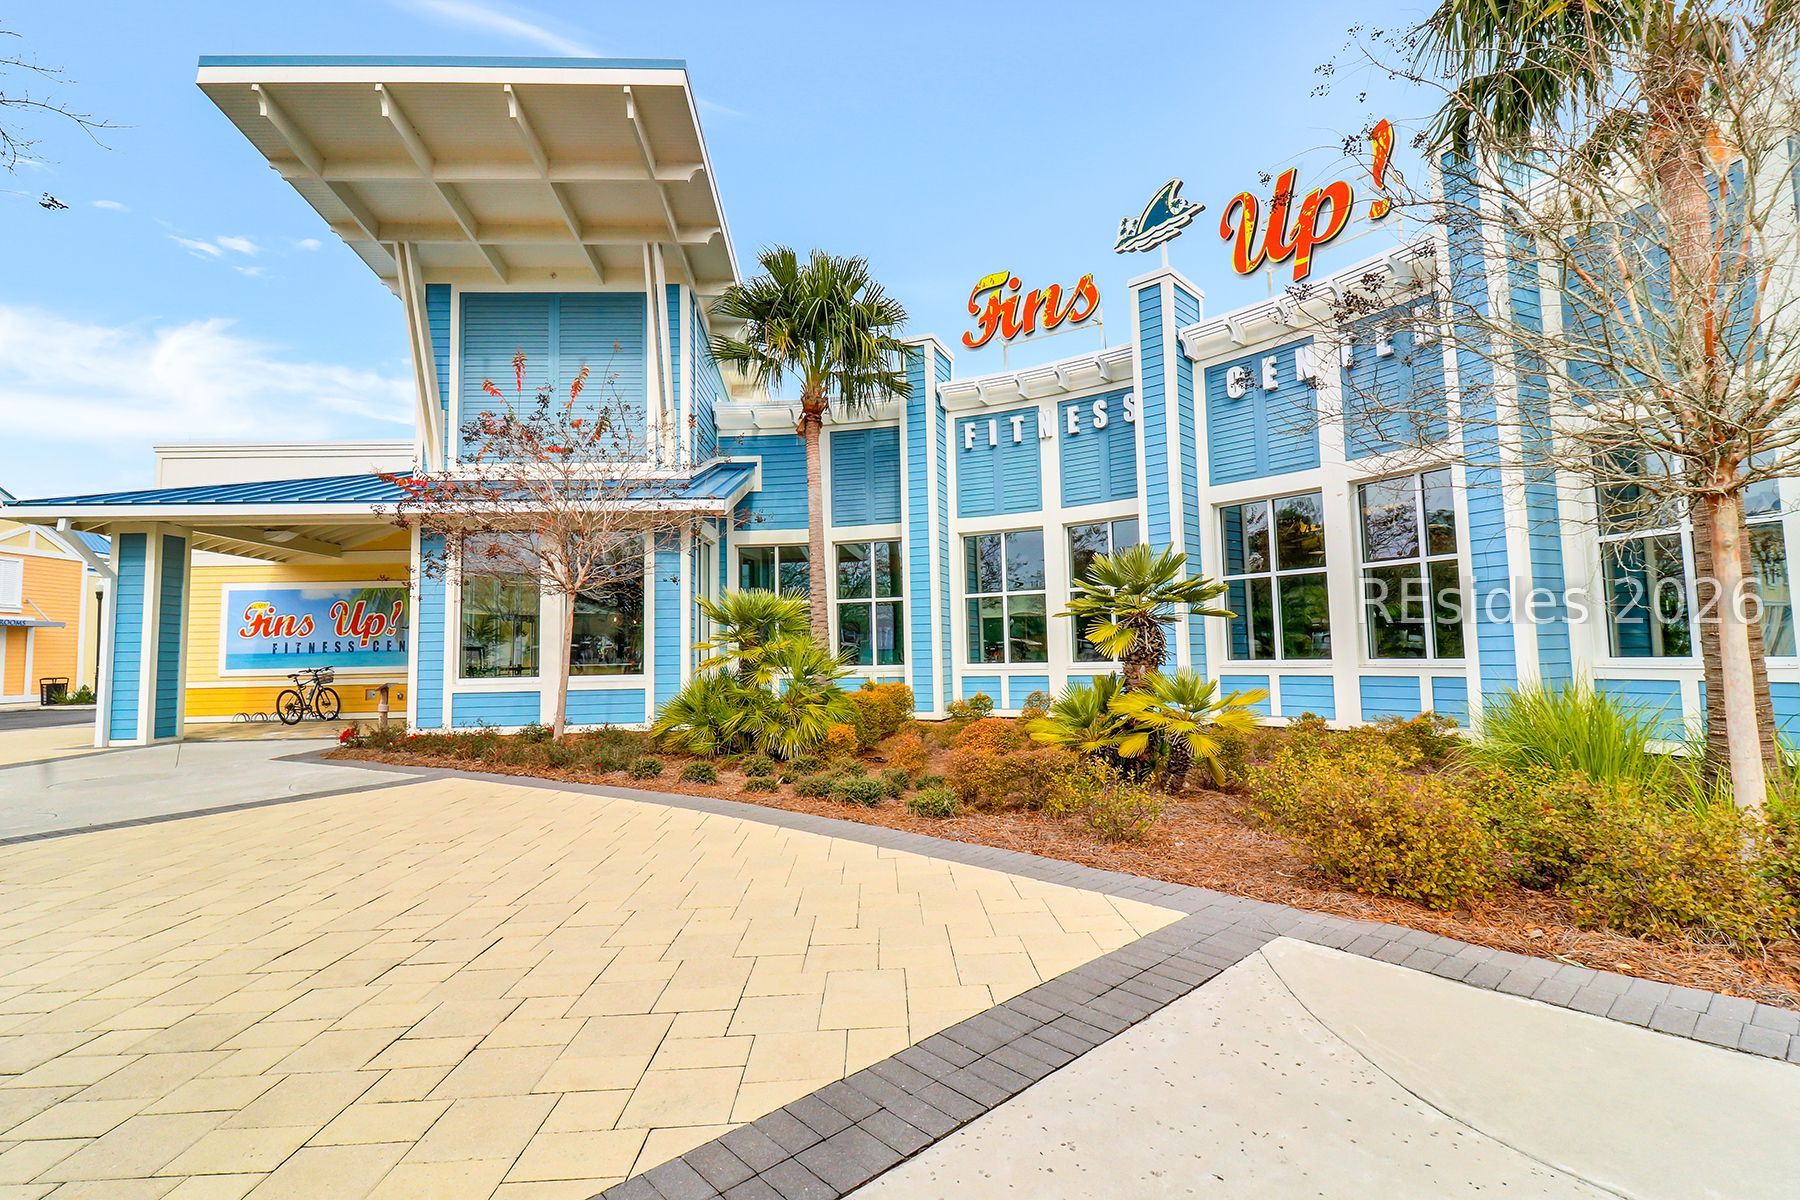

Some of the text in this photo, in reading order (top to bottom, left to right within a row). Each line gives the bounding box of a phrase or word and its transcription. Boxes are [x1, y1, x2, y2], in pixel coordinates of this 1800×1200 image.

[961, 118, 1397, 349] Fins Up!
[964, 393, 1135, 449] FITNESS
[239, 600, 404, 648] Fins Up!
[272, 640, 406, 655] FITNESS CEN
